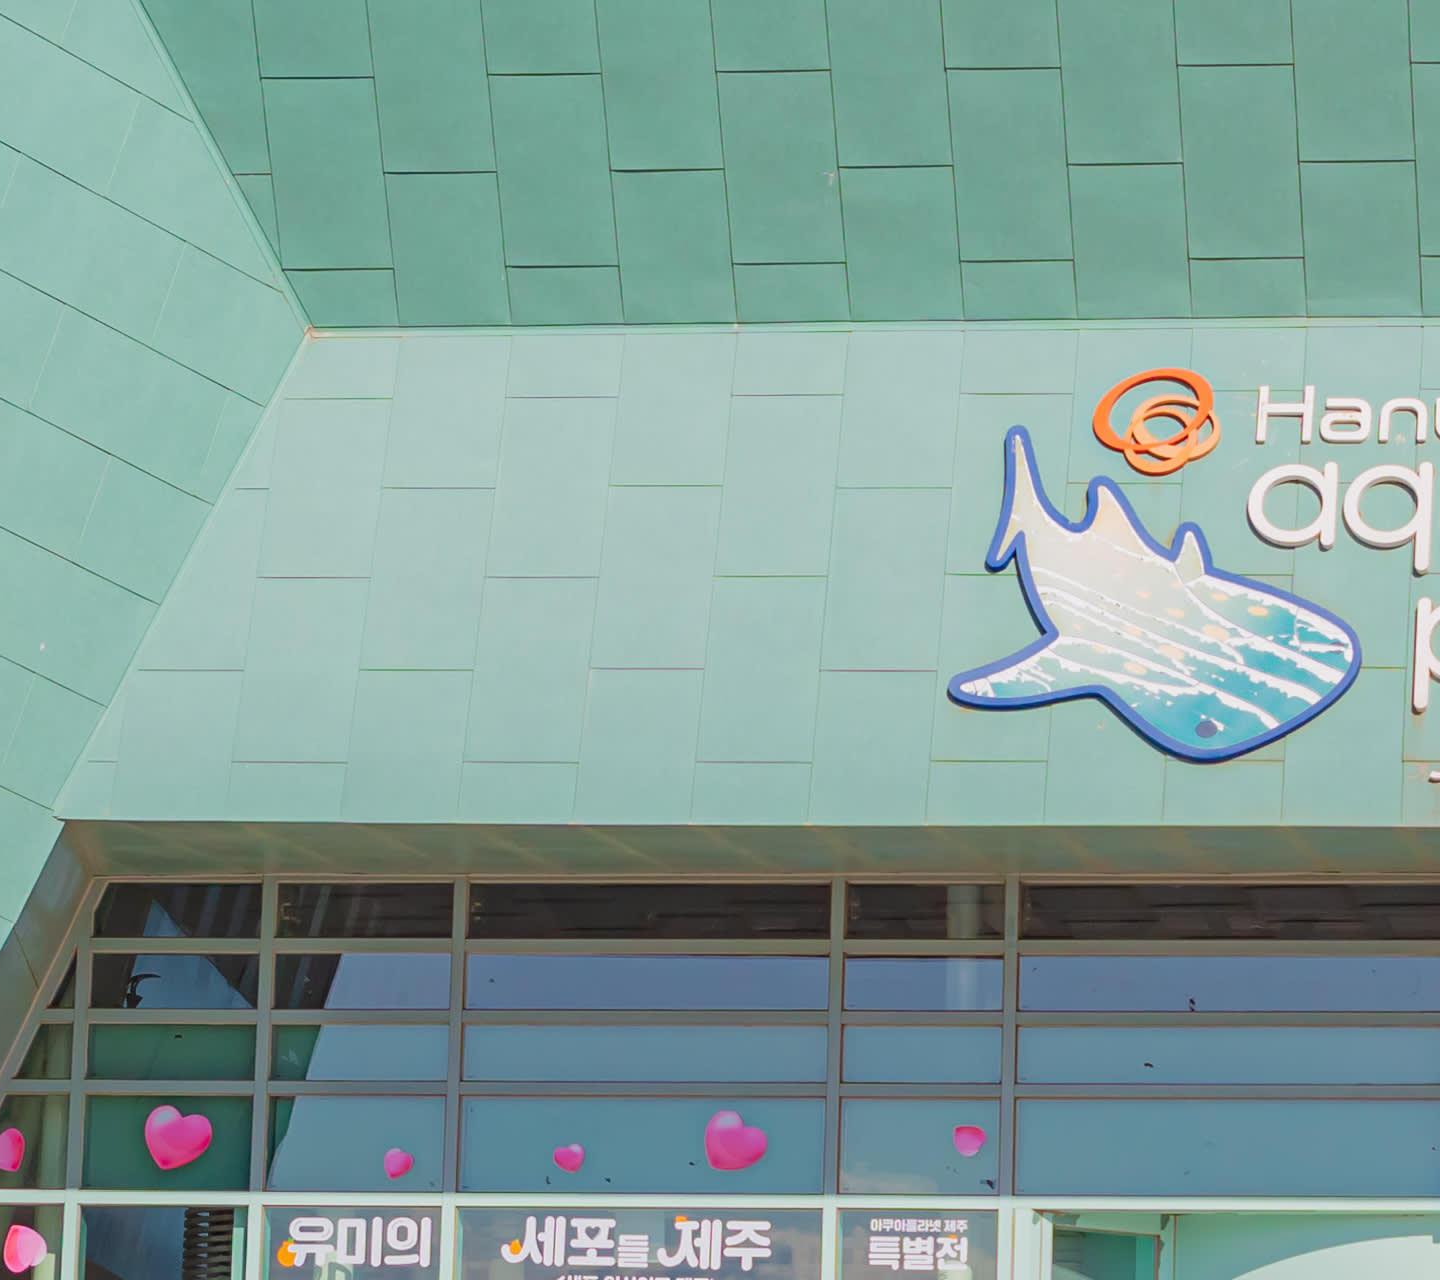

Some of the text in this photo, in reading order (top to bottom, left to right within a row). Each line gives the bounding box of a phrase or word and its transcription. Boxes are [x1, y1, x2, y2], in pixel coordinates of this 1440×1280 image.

[286, 1215, 772, 1272] 유미의 세포들 제주
[943, 1219, 968, 1233] 제주
[868, 1235, 969, 1271] 특별전
